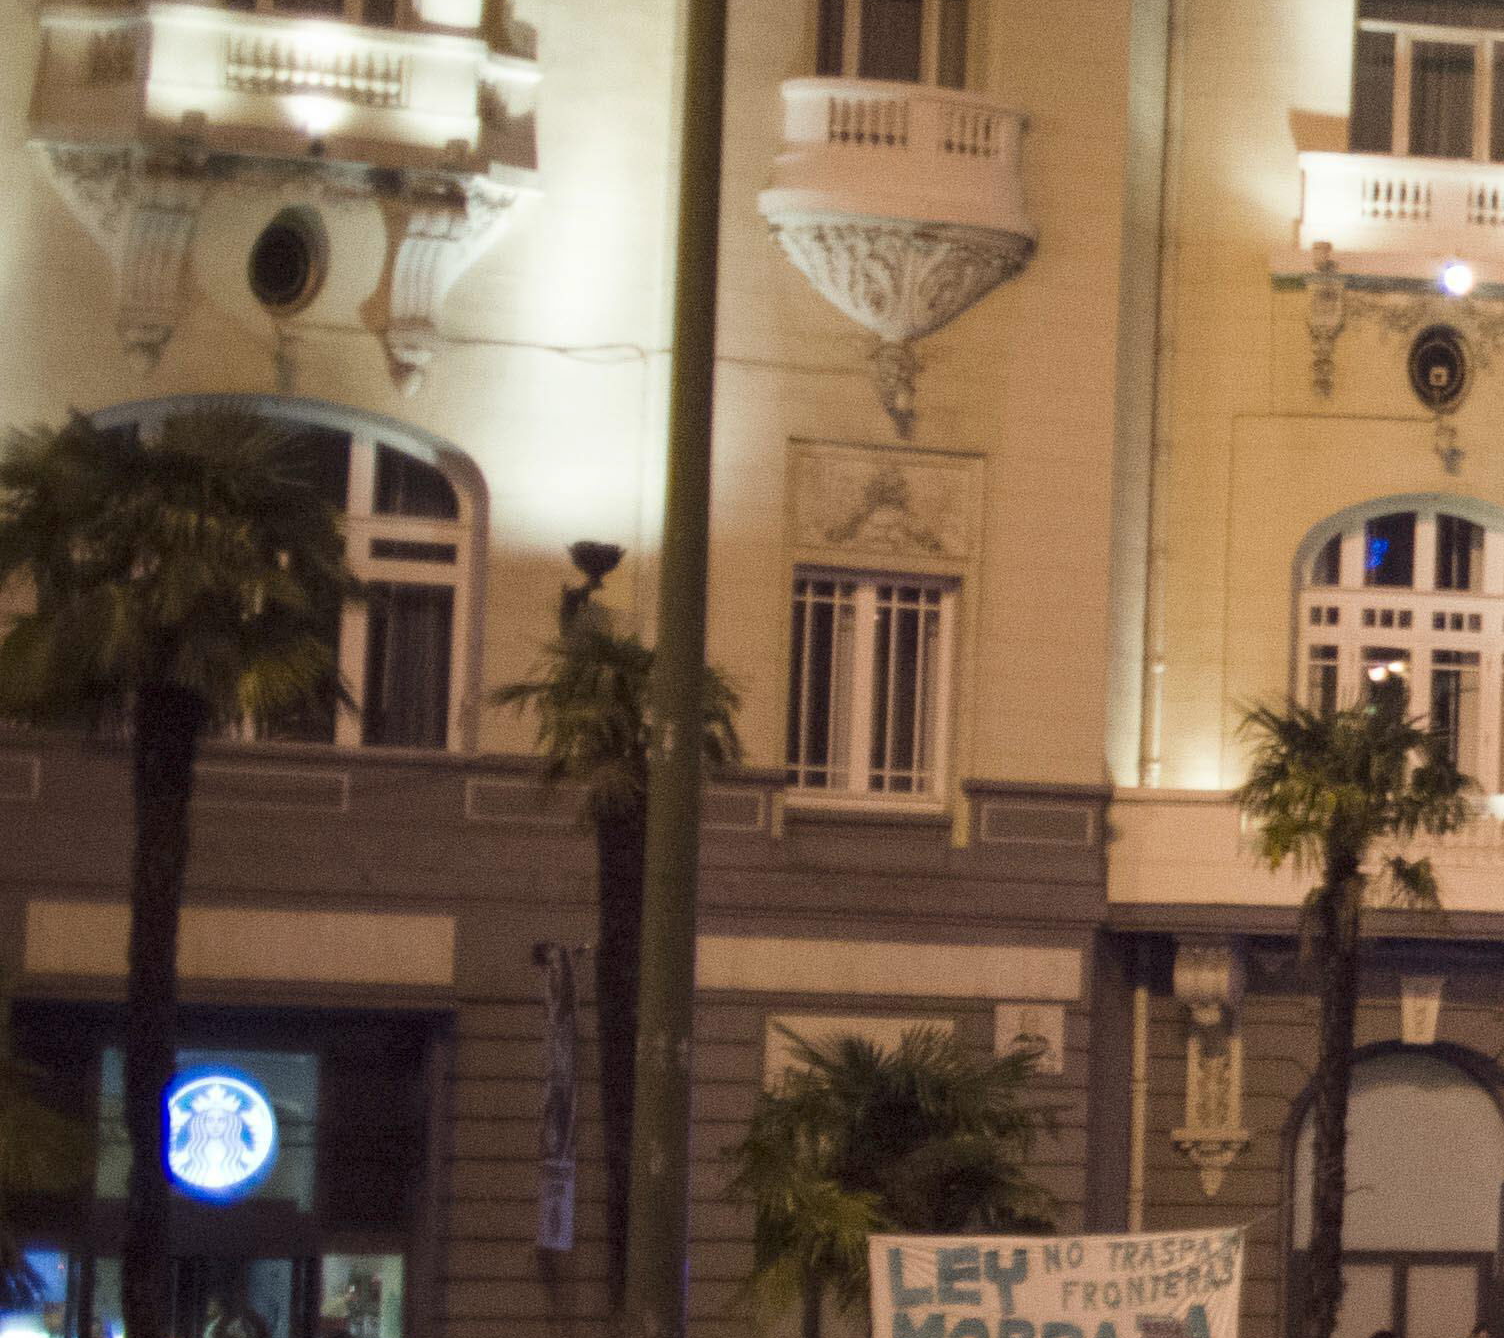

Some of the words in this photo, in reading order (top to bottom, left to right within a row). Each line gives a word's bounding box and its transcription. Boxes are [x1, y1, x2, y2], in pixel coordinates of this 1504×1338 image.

[887, 1247, 1028, 1316] LEY
[1043, 1244, 1084, 1272] NO
[1062, 1260, 1233, 1311] FRONTERAS
